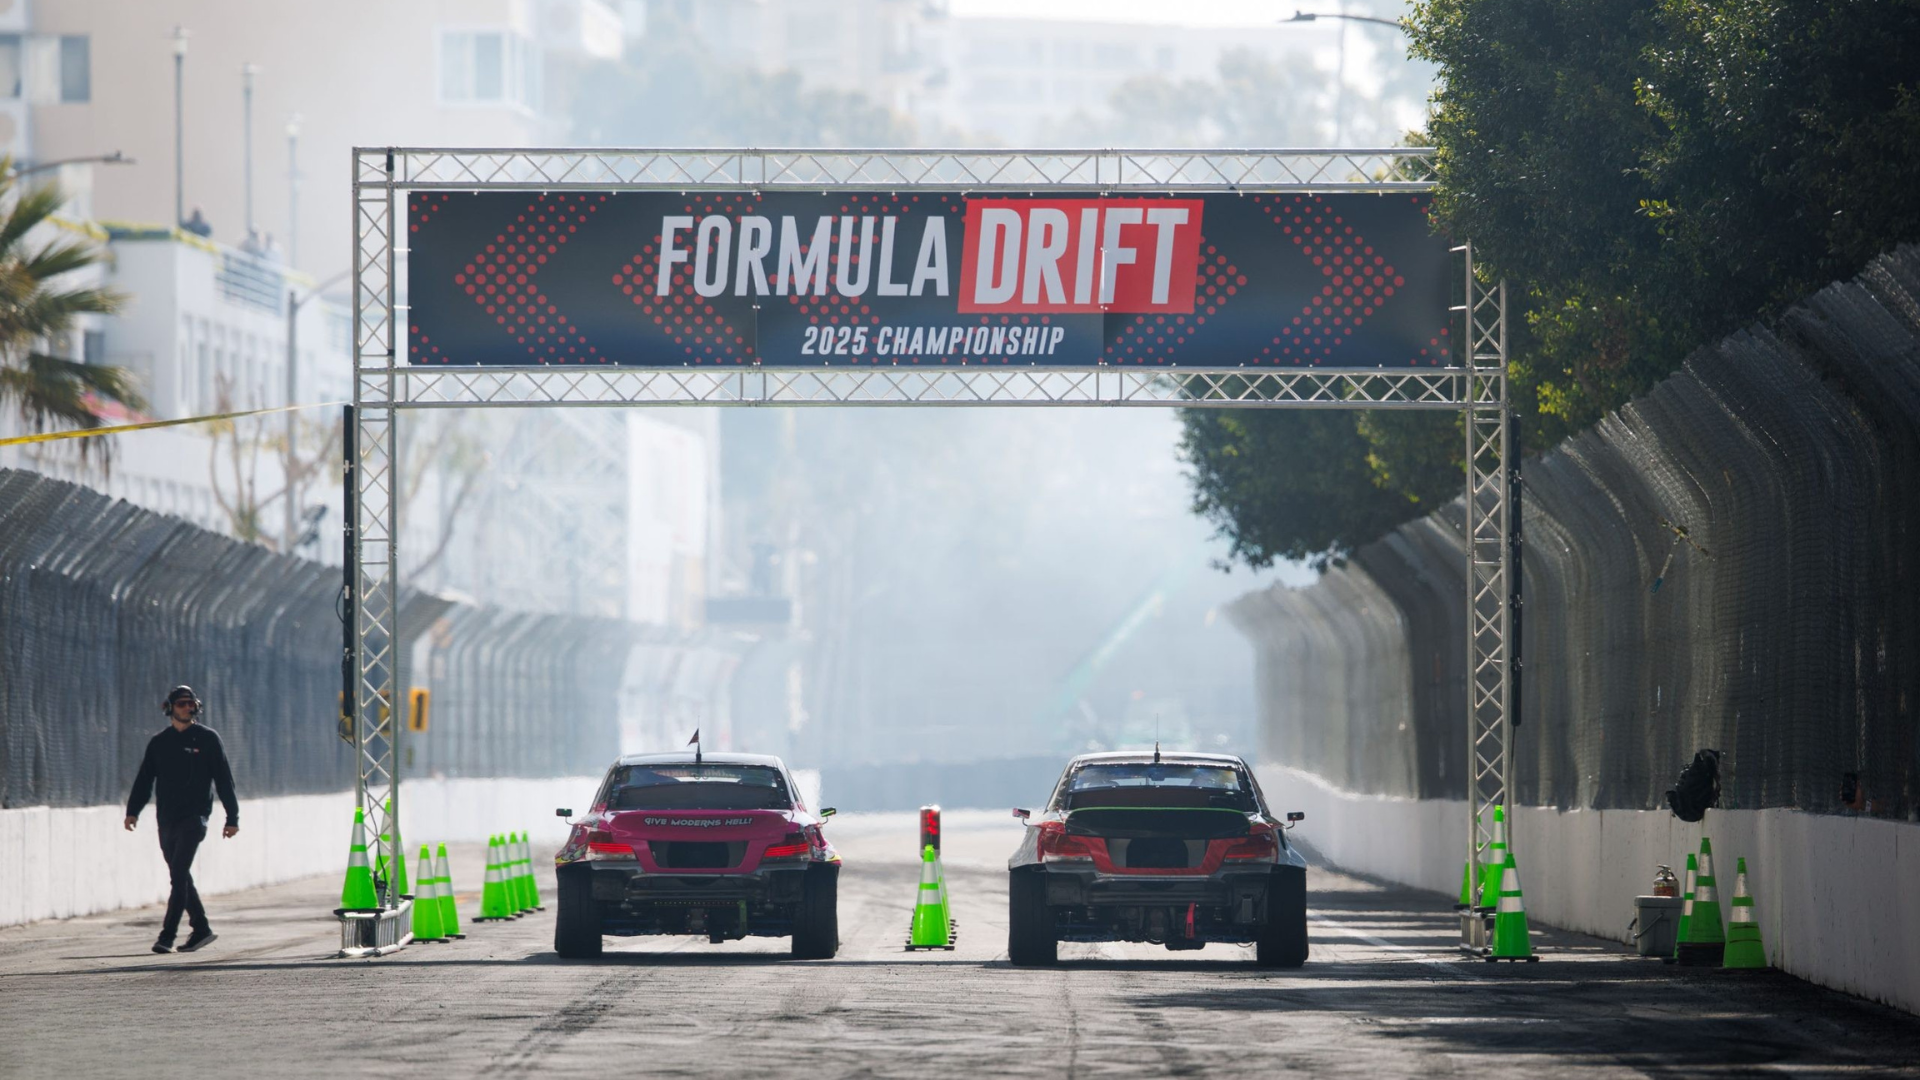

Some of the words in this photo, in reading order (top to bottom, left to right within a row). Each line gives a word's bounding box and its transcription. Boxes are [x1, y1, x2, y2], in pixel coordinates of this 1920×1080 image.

[656, 214, 950, 299] FORMULA
[973, 207, 1189, 305] DRIFT
[801, 325, 868, 356] 2025
[877, 325, 1065, 356] CHAMPIONSHIP
[644, 817, 668, 826] GIVE
[670, 818, 722, 828] MODERNS
[724, 817, 753, 826] HELL!
